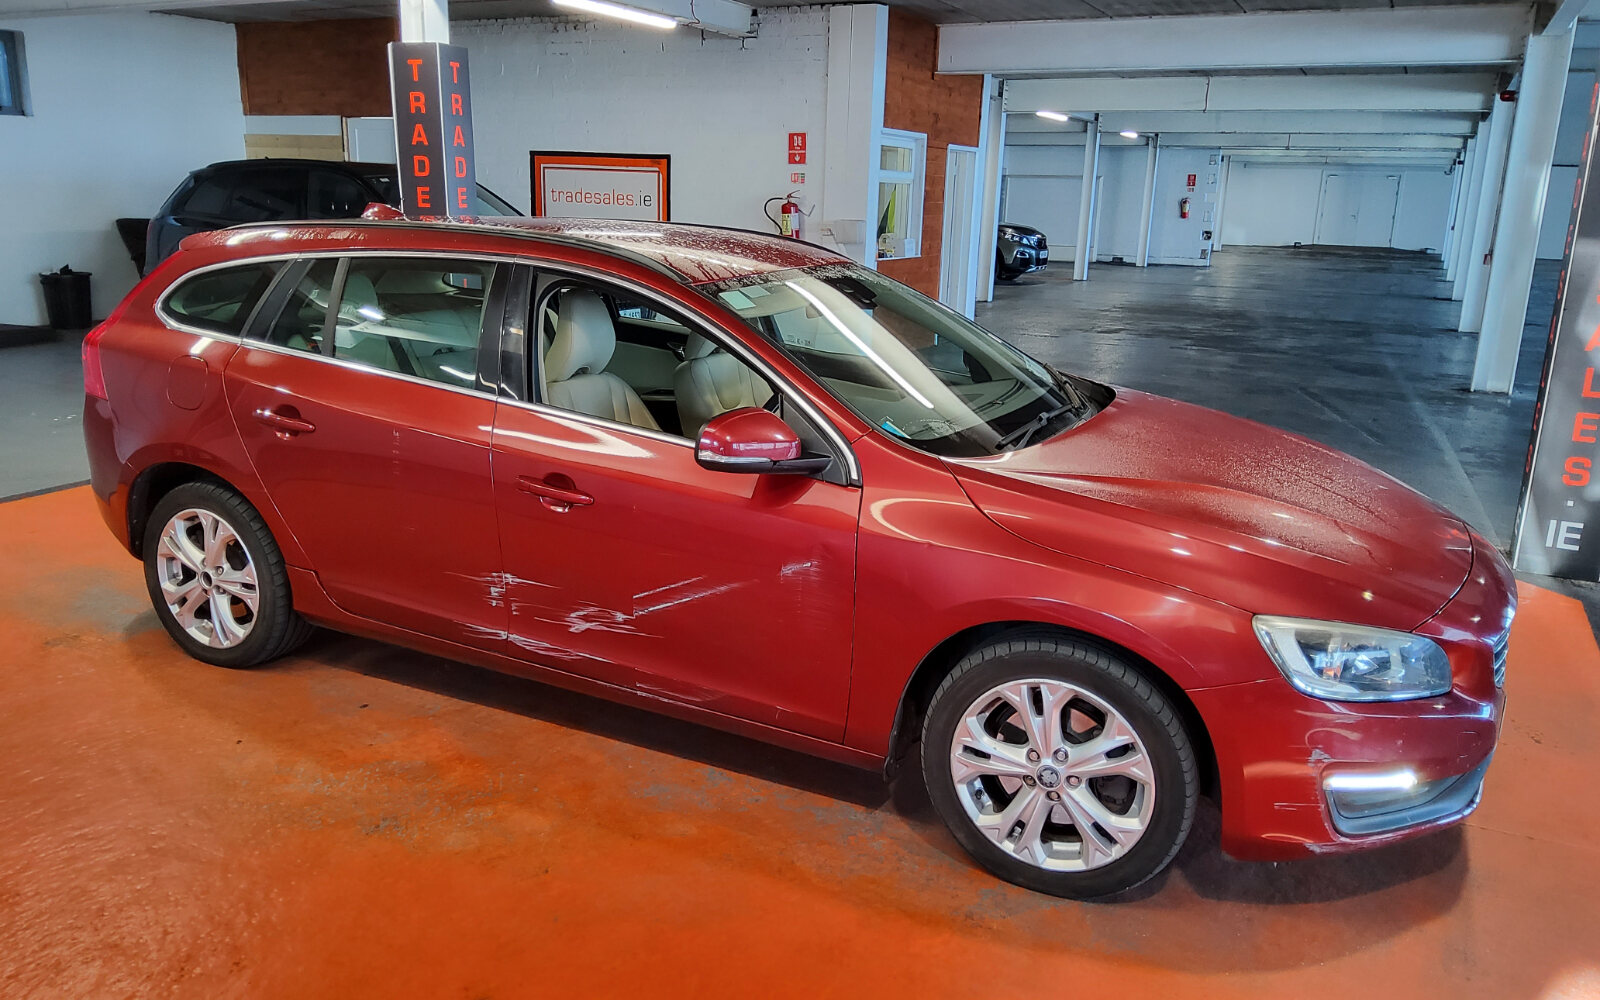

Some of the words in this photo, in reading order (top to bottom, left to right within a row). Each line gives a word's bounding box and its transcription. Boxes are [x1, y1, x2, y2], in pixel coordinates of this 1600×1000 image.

[407, 58, 431, 208] TRADE
[449, 61, 468, 209] TRADE
[551, 187, 652, 207] tradesales.ie
